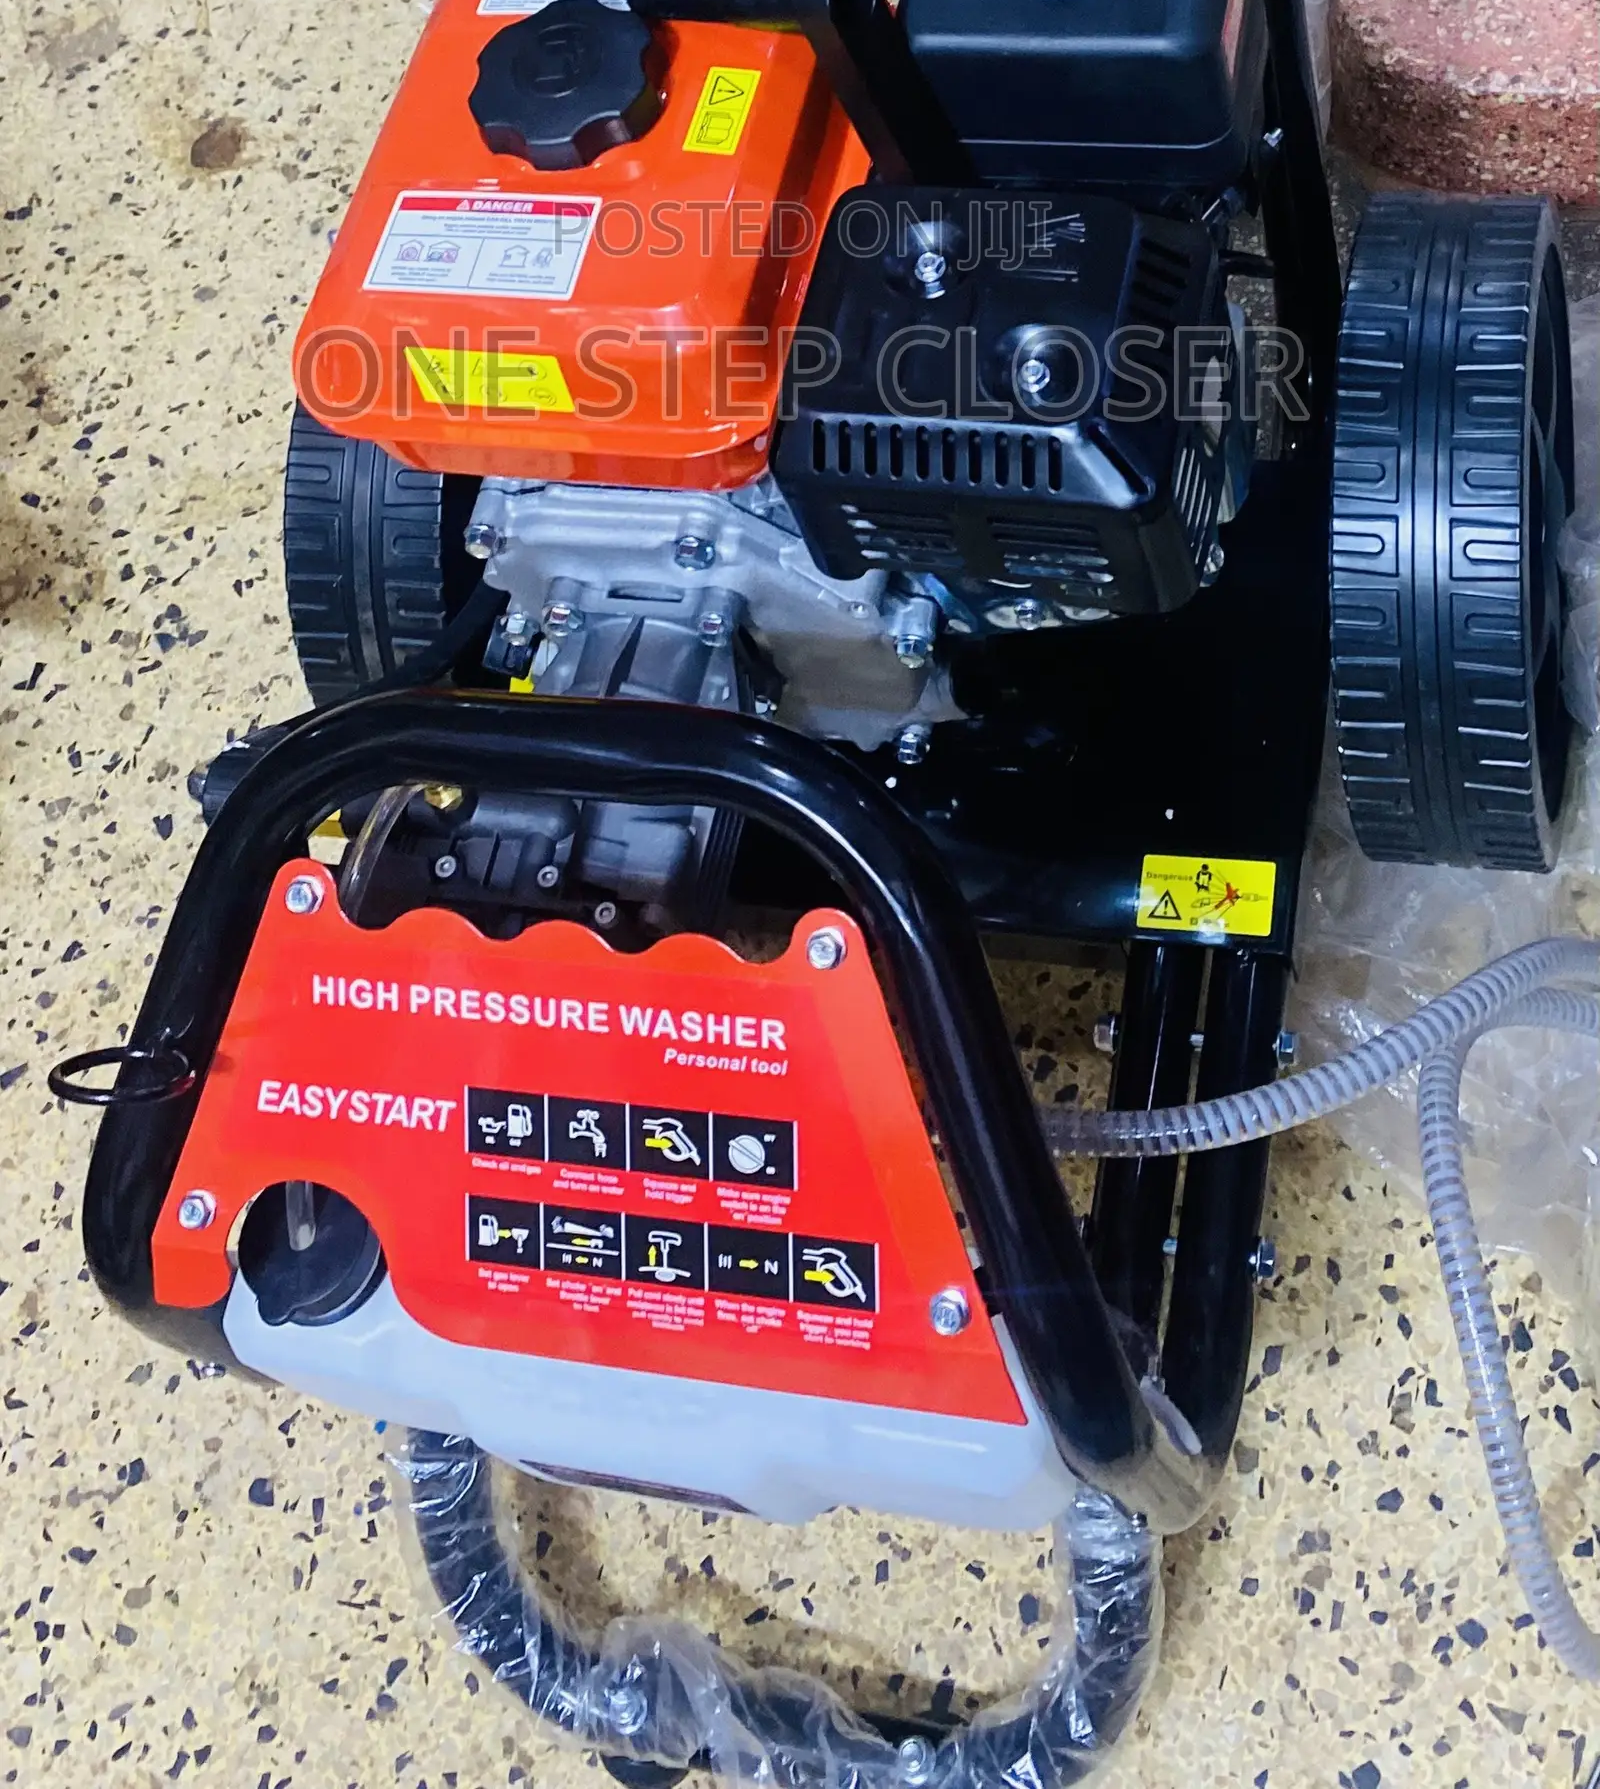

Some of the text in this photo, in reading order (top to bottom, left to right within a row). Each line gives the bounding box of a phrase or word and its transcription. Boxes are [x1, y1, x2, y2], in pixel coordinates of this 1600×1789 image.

[472, 200, 534, 213] DANGER
[312, 974, 787, 1051] HIGH PRESSURE WASHER
[663, 1047, 788, 1076] Personal tool
